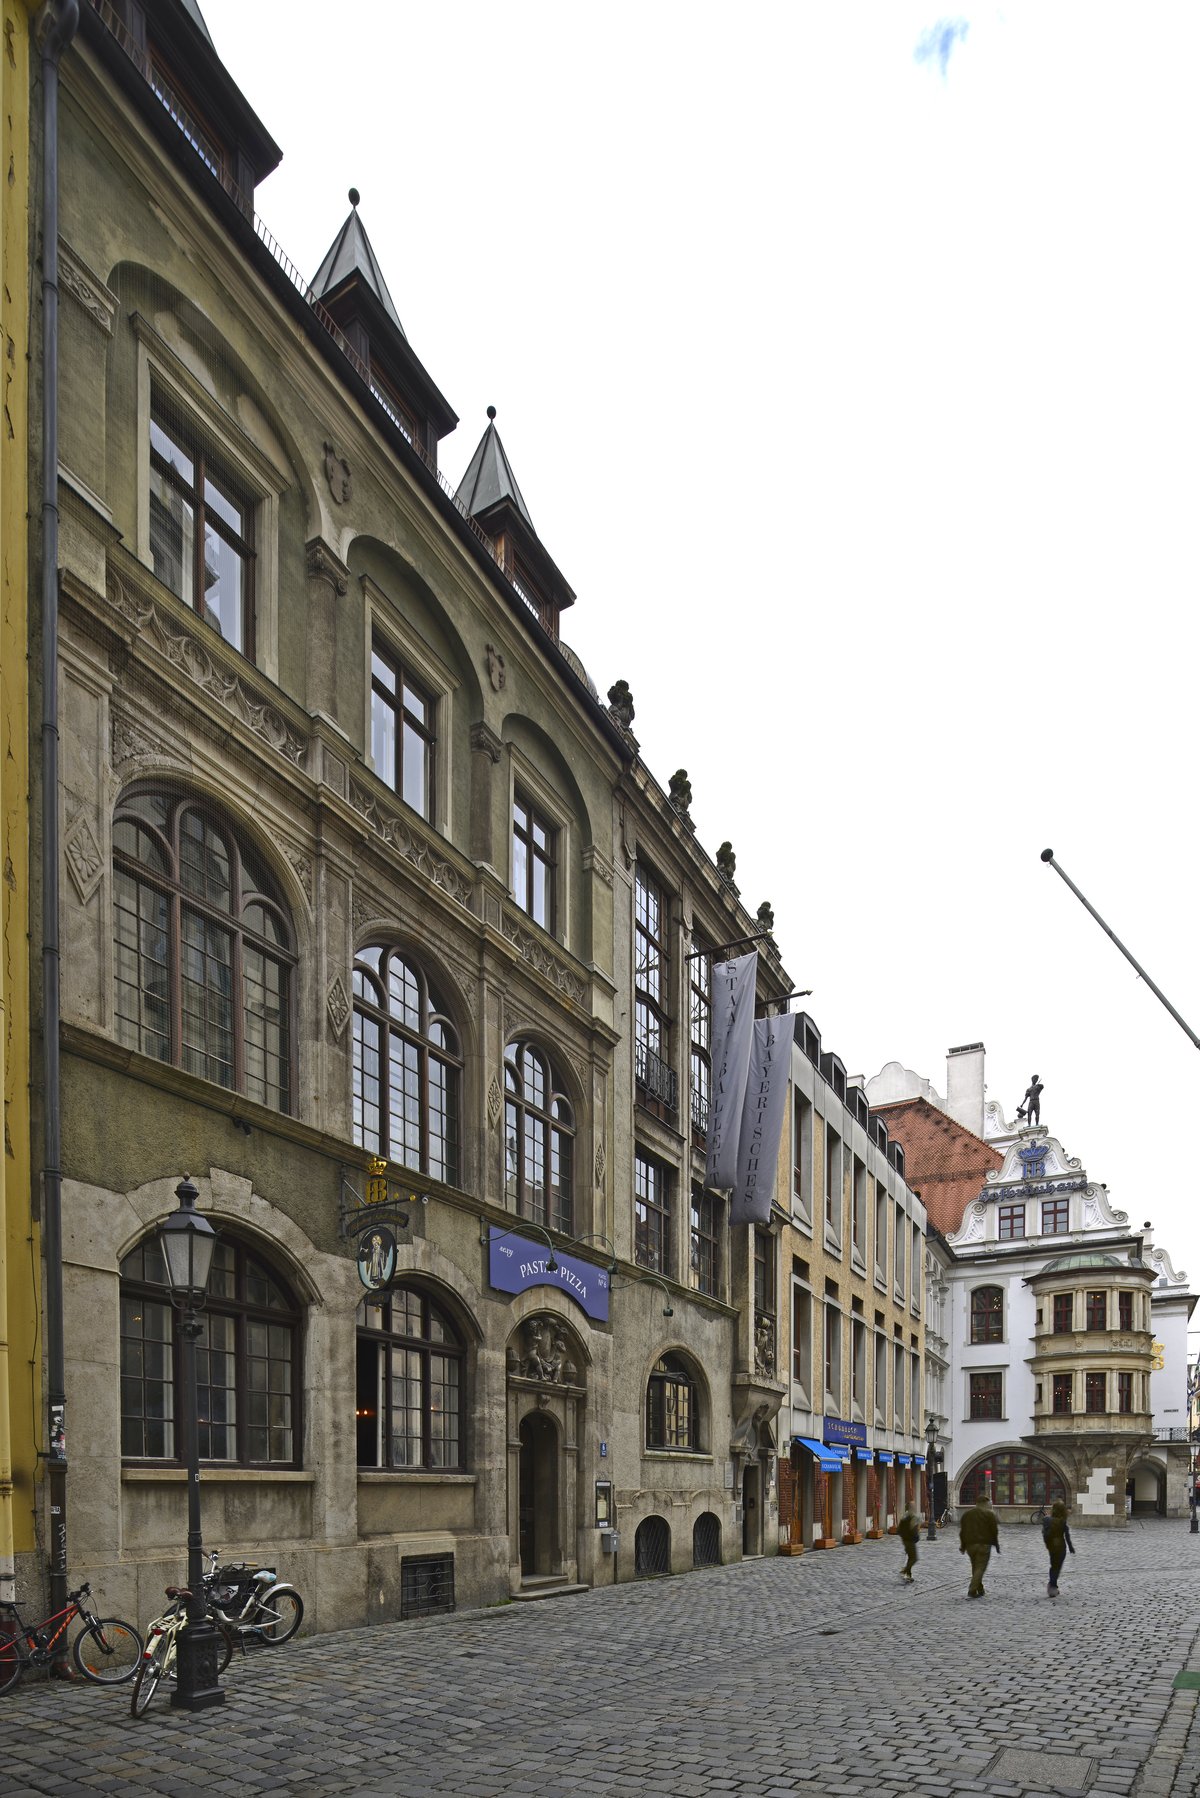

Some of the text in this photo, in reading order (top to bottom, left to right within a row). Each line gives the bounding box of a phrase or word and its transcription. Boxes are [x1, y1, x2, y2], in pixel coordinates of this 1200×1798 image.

[709, 960, 738, 1188] STAABALLETT
[744, 1033, 776, 1202] BAYERISCHES
[560, 1266, 587, 1299] PIZZA
